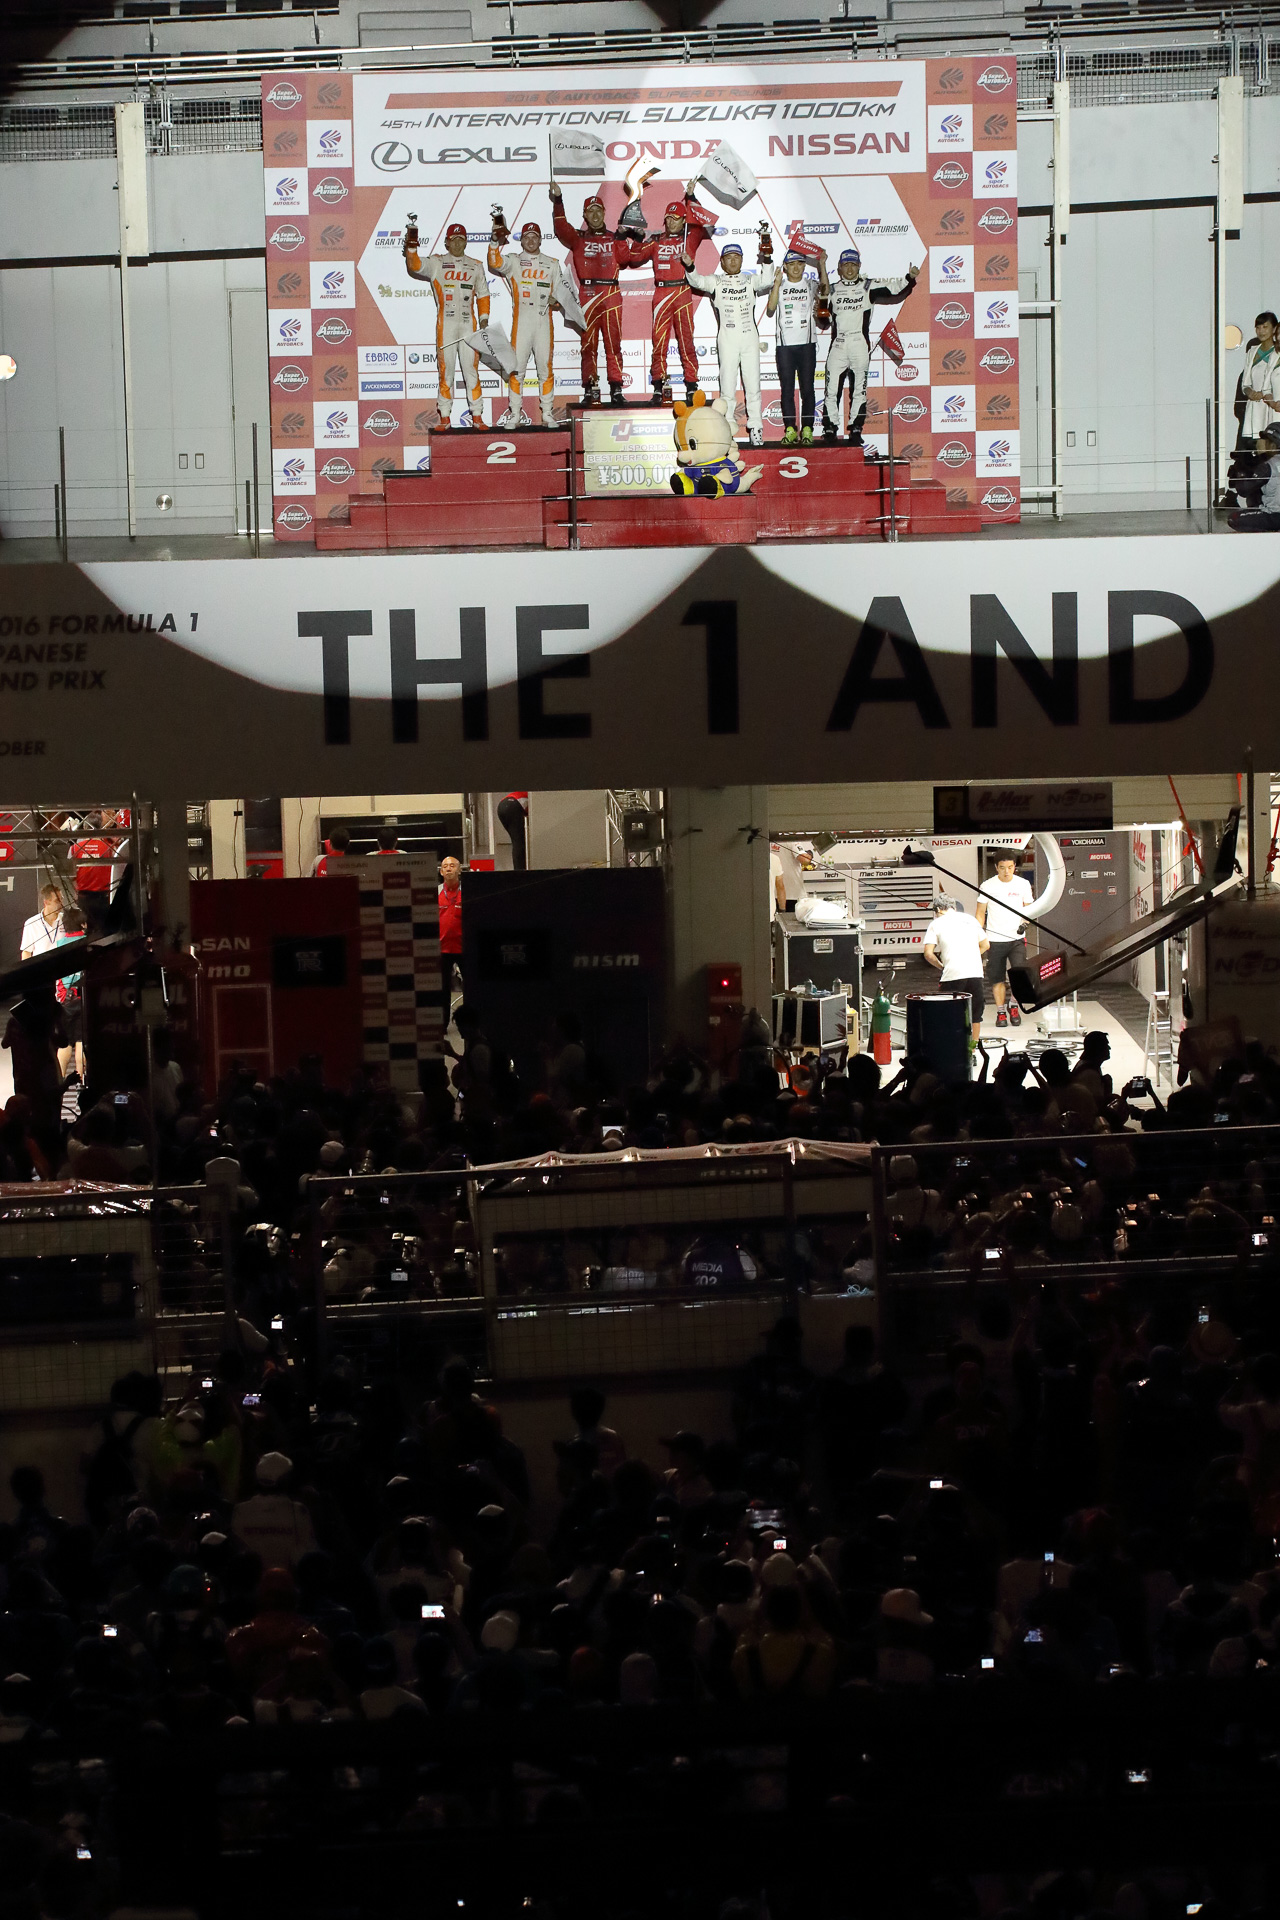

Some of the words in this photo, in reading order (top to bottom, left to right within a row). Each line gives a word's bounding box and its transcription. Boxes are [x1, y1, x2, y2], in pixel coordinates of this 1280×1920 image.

[563, 91, 640, 100] AUTOBACS
[648, 90, 702, 98] SUPER
[381, 120, 422, 128] 45TH
[425, 111, 638, 128] INTERNATIONAL
[642, 104, 777, 123] SUZUKA
[782, 102, 896, 119] 1000KM
[604, 138, 723, 161] ONDA
[769, 132, 910, 156] NISSAN
[417, 146, 537, 163] LEXUS
[854, 226, 874, 234] GRAN
[375, 238, 395, 246] GRAN
[585, 242, 614, 252] ZENT
[658, 244, 685, 254] ZENT
[444, 270, 472, 281] au
[522, 268, 548, 280] au
[365, 352, 398, 362] EBBRO
[423, 354, 437, 362] BM
[619, 423, 630, 436] J
[633, 426, 668, 434] SPORTS
[486, 442, 516, 464] 2
[588, 455, 612, 463] BEST
[616, 453, 677, 462] PERFORMAN
[779, 456, 808, 478] 3
[48, 613, 177, 635] FORMULA
[190, 613, 198, 631] 1
[297, 604, 592, 745] THE
[680, 600, 739, 734] 1
[825, 590, 1215, 732] AND
[47, 670, 107, 690] PRIX
[873, 937, 921, 945] nismo
[692, 1262, 723, 1273] MEDIA
